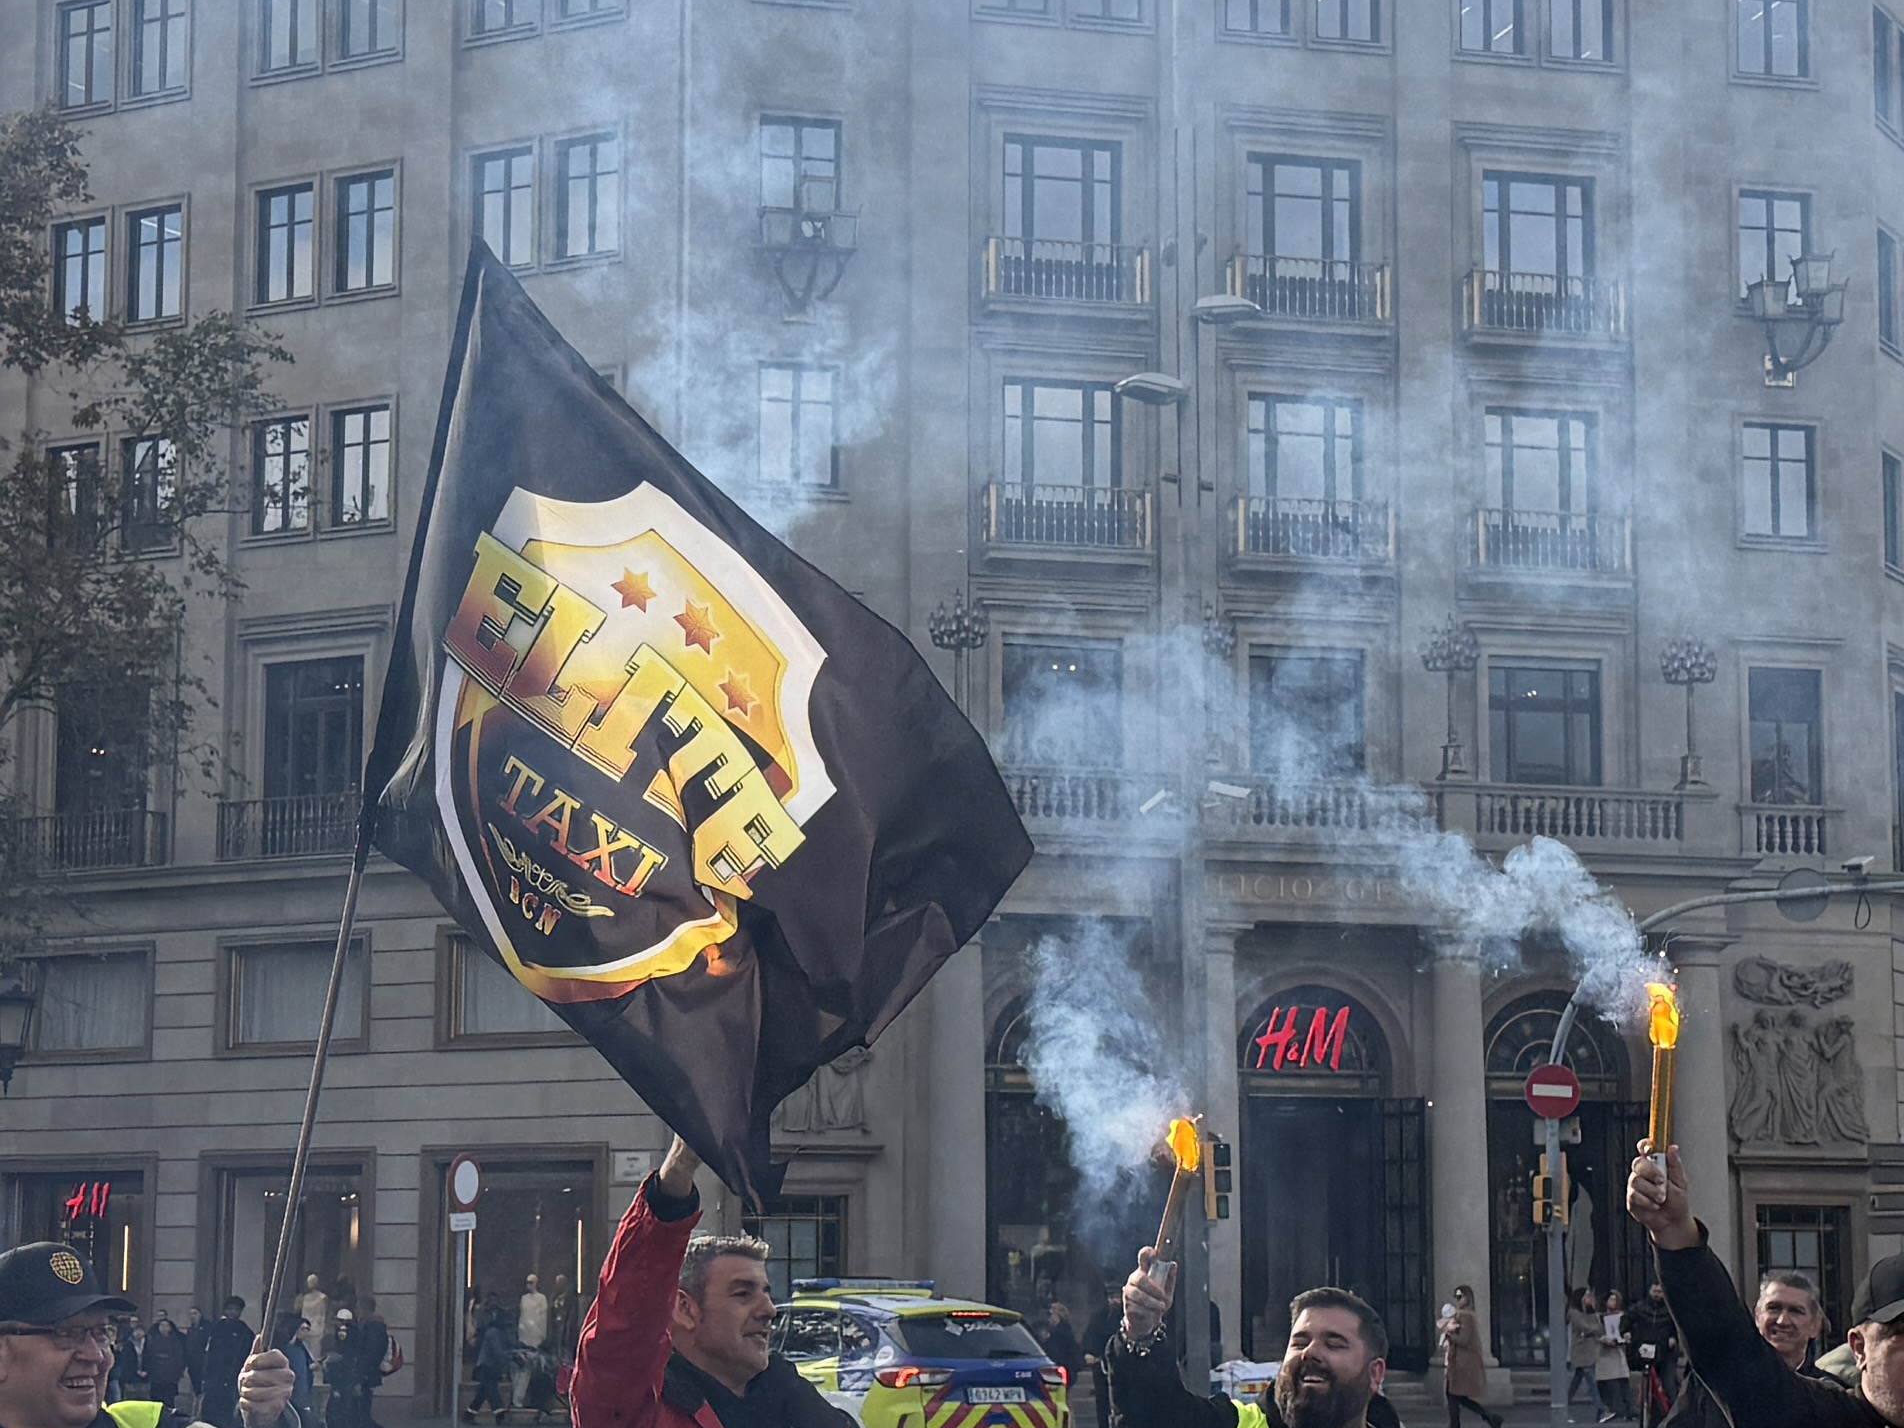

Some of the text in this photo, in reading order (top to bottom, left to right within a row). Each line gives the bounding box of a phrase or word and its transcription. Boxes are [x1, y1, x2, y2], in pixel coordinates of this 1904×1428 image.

[442, 530, 807, 900] ELITE
[498, 755, 670, 899] TAXI
[1255, 1005, 1351, 1071] H&M
